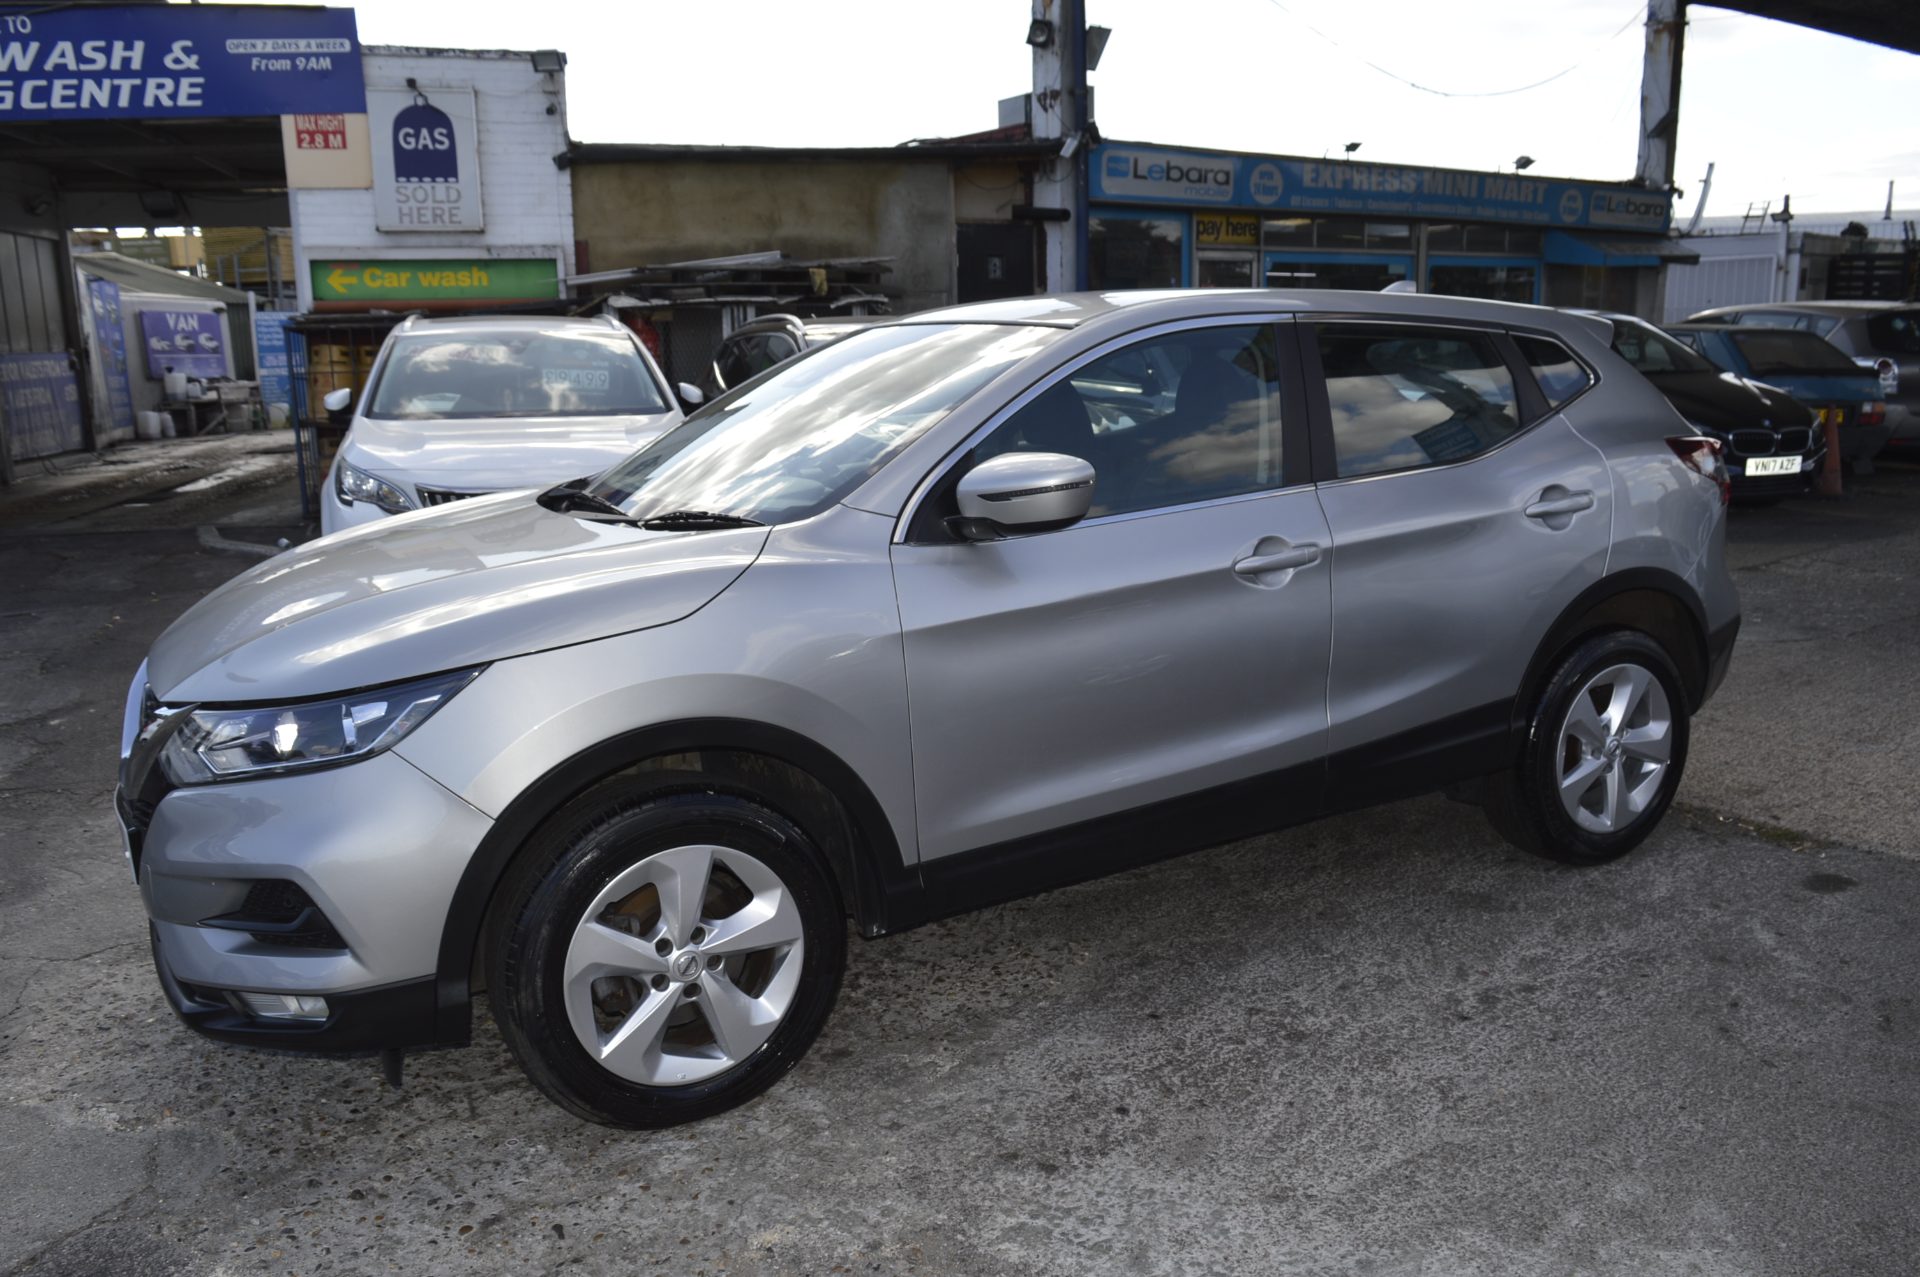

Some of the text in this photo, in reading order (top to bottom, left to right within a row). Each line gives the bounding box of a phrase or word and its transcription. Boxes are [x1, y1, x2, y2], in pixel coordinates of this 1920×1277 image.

[6, 15, 32, 34] TO
[228, 39, 347, 51] OPEN 7 DAYS A WEEK
[163, 40, 200, 71] &
[251, 56, 333, 72] From 9AM
[299, 133, 343, 149] 2.8 M
[398, 127, 450, 150] GAS
[1132, 157, 1231, 186] Lebara
[1184, 185, 1230, 198] mobile
[1302, 163, 1418, 193] EXPRESS
[1423, 170, 1478, 198] MINI
[1484, 176, 1549, 206] MART
[395, 185, 462, 205] SOLD
[398, 206, 462, 225] HERE
[1606, 195, 1665, 218] Lebara
[1196, 215, 1258, 240] pay here
[362, 266, 489, 289] Car wash
[165, 312, 199, 331] VAN
[1754, 458, 1797, 473] VN17 AZF
